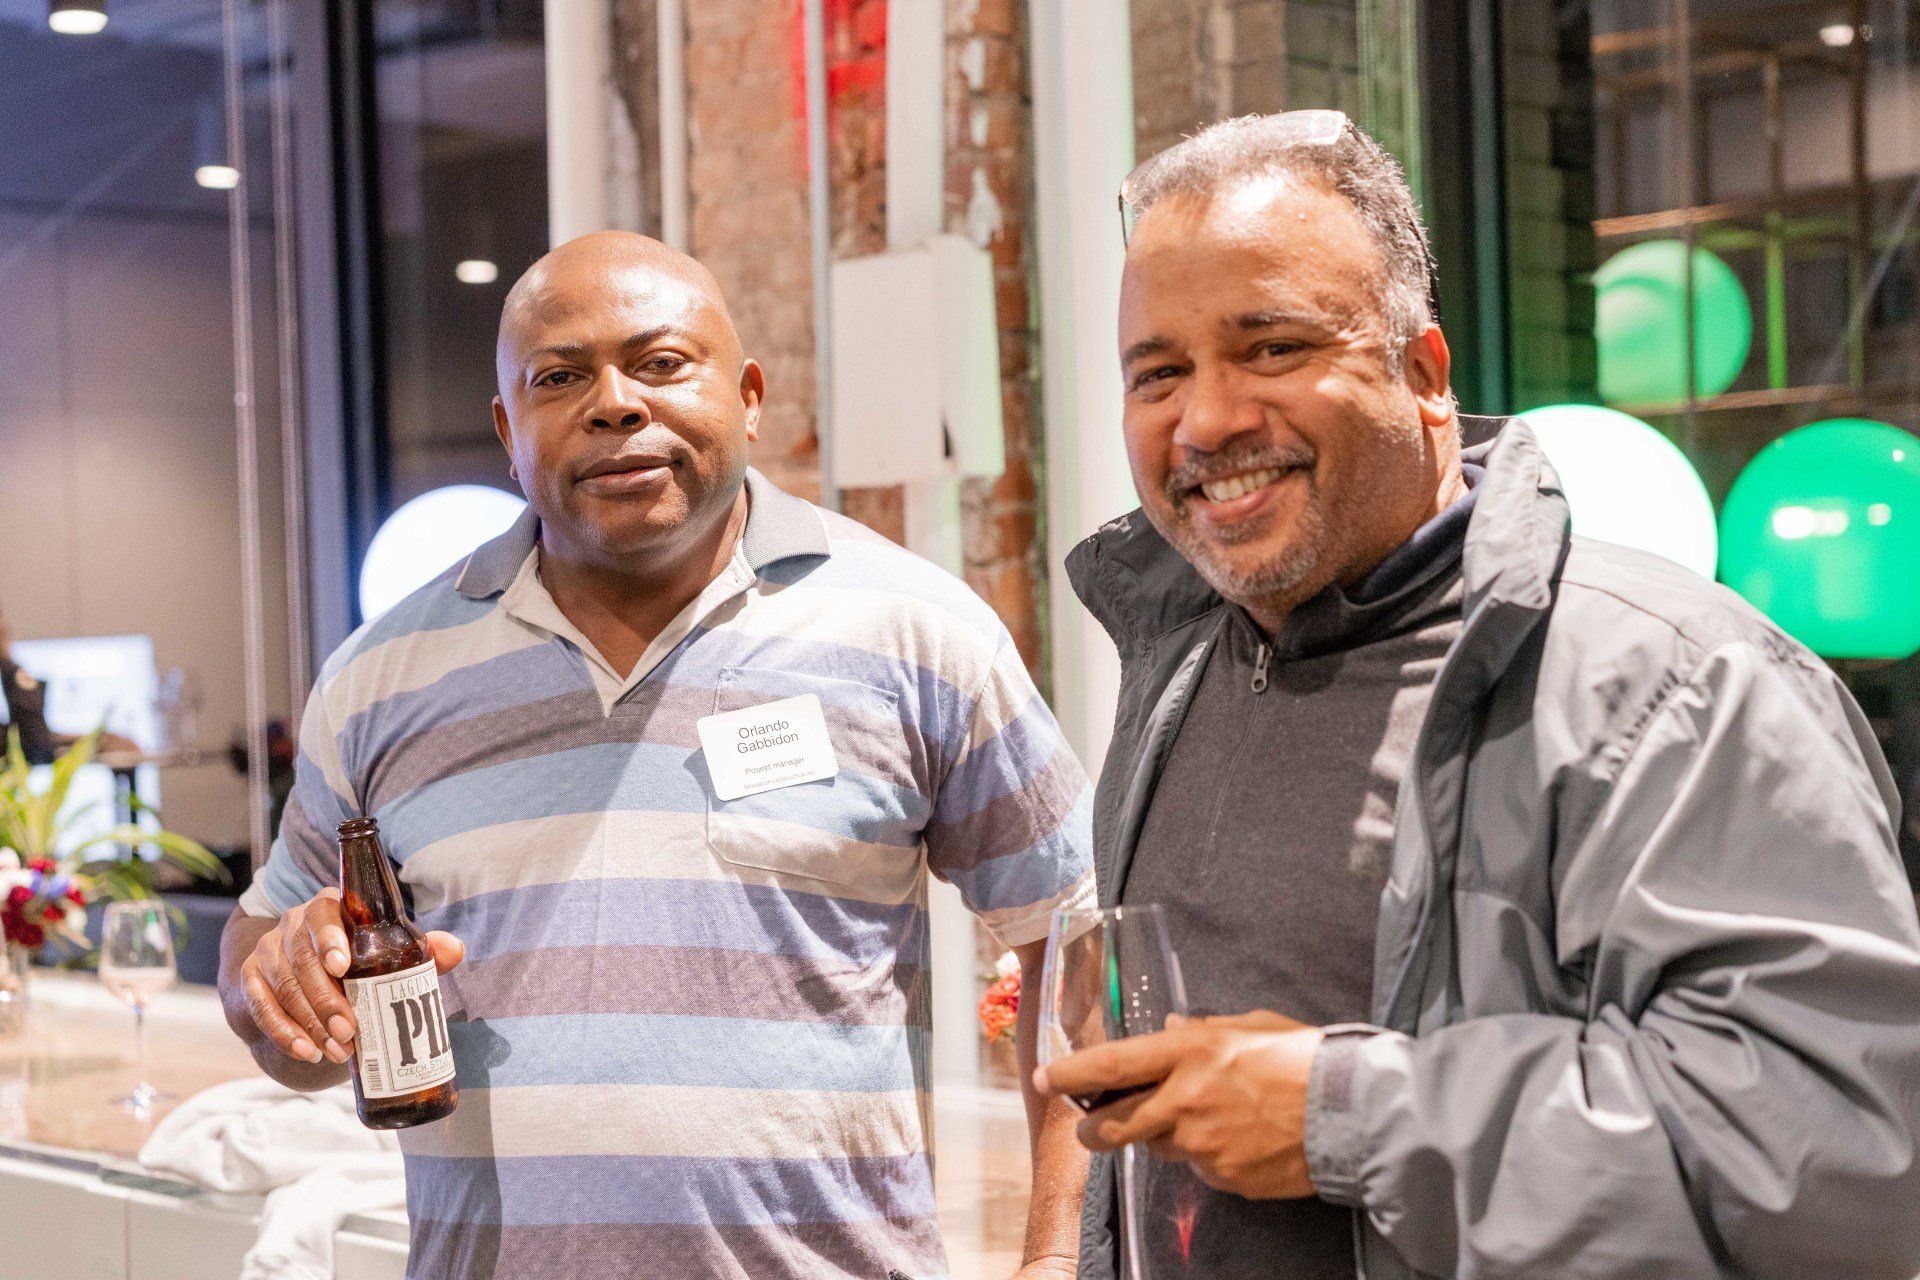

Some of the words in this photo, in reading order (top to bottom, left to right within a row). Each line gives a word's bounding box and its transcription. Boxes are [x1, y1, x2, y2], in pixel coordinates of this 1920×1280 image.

[738, 719, 790, 739] Orlando
[737, 733, 799, 754] Gabbidon
[744, 764, 772, 775] Project
[772, 757, 805, 769] manager
[396, 1064, 428, 1078] CZECH
